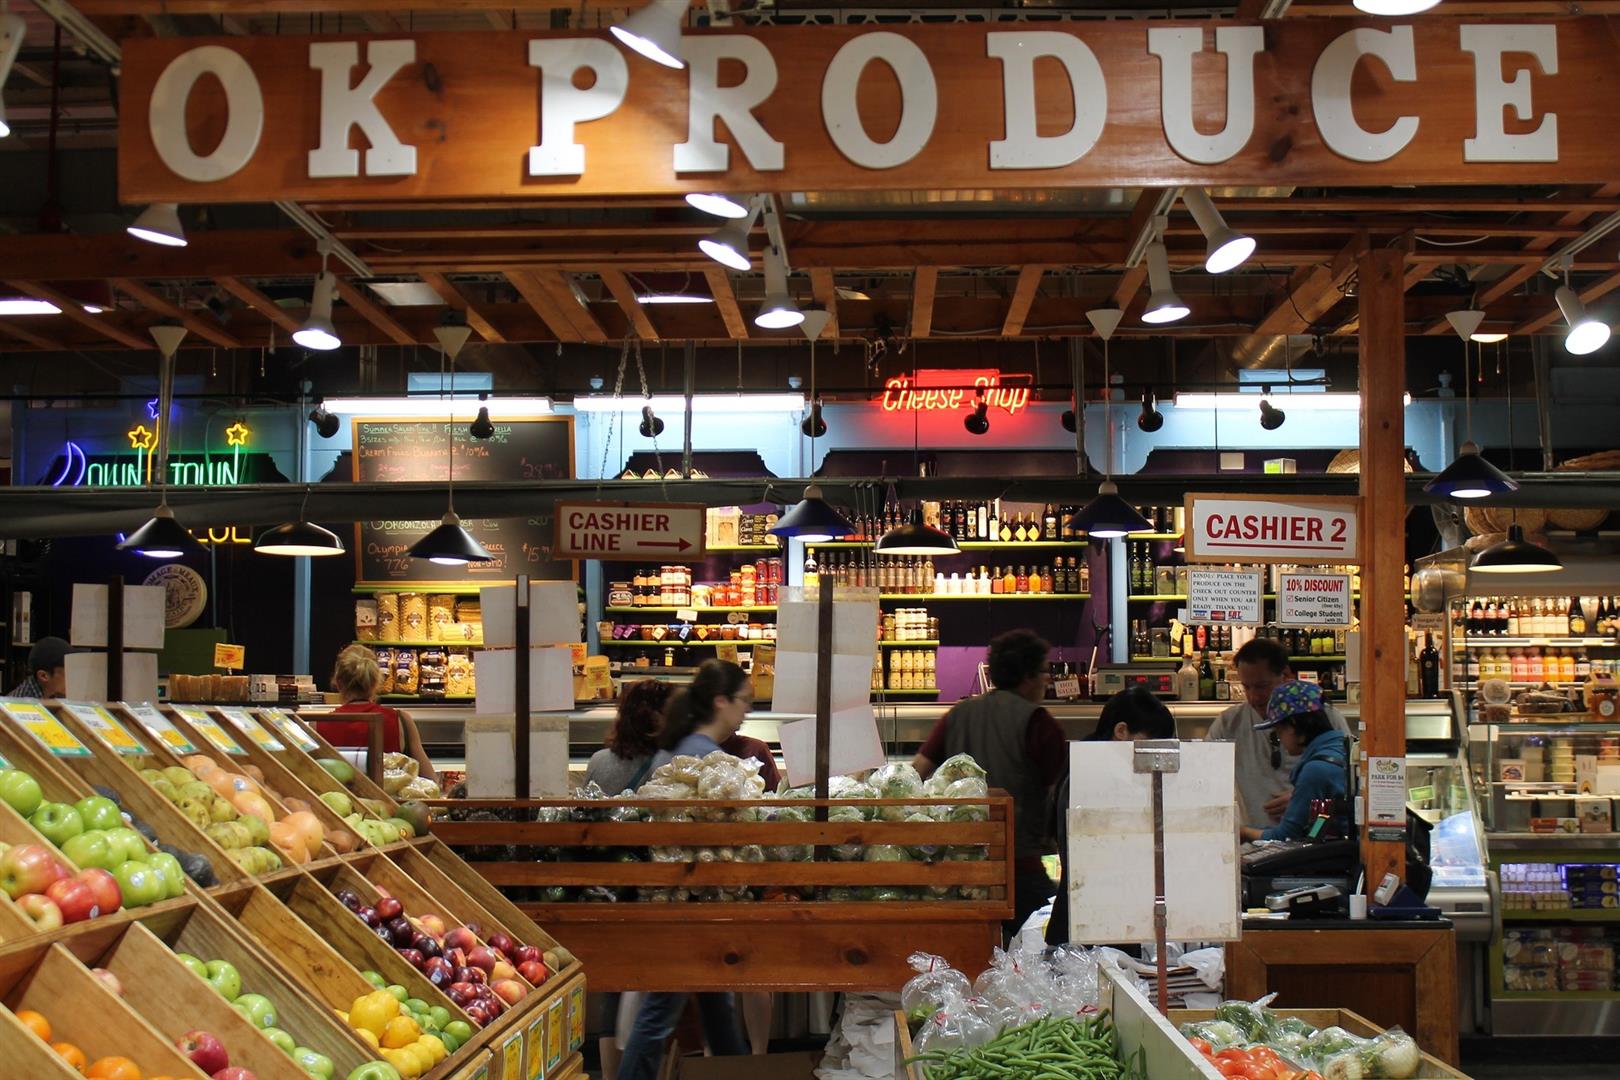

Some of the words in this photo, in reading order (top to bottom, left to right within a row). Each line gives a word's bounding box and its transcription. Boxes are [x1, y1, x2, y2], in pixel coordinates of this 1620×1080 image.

[149, 40, 417, 183] OK
[528, 23, 1559, 178] PRODUCE
[883, 379, 963, 411] Cheese
[970, 376, 1028, 414] Shop
[569, 512, 670, 532] CASHIER
[1206, 513, 1323, 542] CASHIER
[1330, 517, 1347, 542] 2
[570, 533, 621, 551] LINE
[1286, 579, 1302, 591] 10%
[1304, 579, 1344, 592] DISCOUNT
[1294, 610, 1318, 618] College
